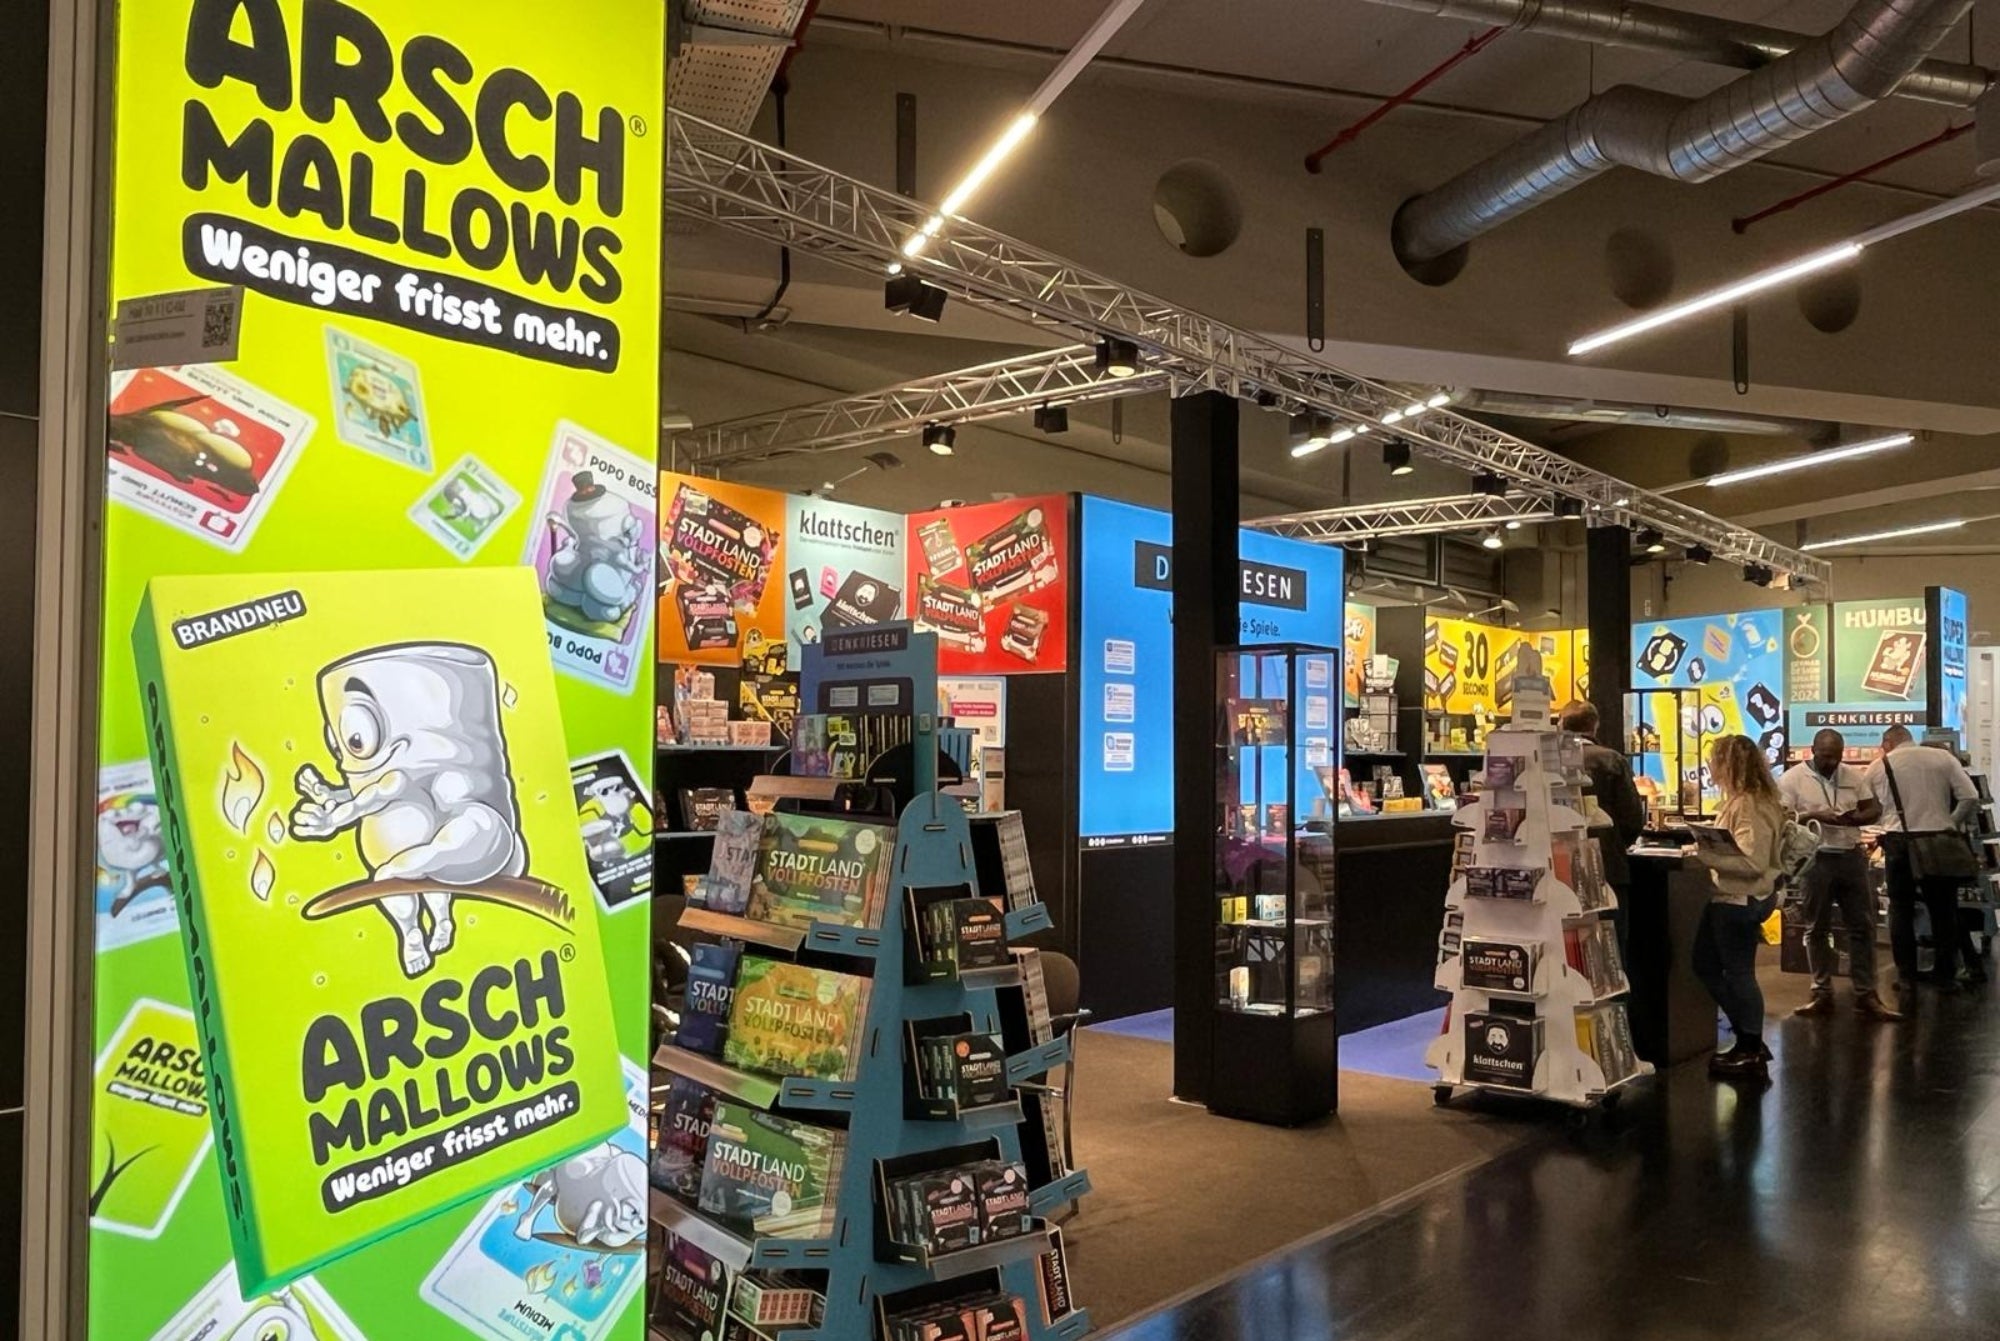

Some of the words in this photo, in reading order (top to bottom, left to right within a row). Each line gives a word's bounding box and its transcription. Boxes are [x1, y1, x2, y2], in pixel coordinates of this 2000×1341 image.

[185, 0, 624, 217] ARSCH
[182, 99, 622, 304] MALLOWS
[201, 224, 381, 305] Weniger
[395, 273, 502, 334] frisst
[513, 313, 609, 360] mehr.
[590, 456, 624, 480] POPO
[678, 518, 725, 549] STADT
[723, 539, 761, 569] LAND
[800, 509, 895, 548] klattschen
[676, 533, 757, 579] VOLLPFOSTEN
[972, 552, 1008, 577] STADT
[1008, 534, 1040, 557] LAND
[177, 594, 303, 646] BRANDNEU
[924, 597, 956, 613] STADT
[955, 606, 979, 620] LAND
[1250, 619, 1281, 639] Spiele.
[566, 640, 602, 664] POPO
[1464, 630, 1489, 680] 30
[1462, 682, 1489, 697] SECONDS
[1818, 714, 1914, 724] DENKRIESEN
[768, 867, 861, 894] VOLLPFOSTEN
[769, 850, 819, 872] STADT
[819, 858, 864, 879] LAND
[1469, 956, 1497, 966] STADT
[691, 981, 736, 1001] STADT
[302, 949, 567, 1104] ARSCH
[745, 997, 791, 1021] STADT
[796, 1005, 841, 1030] LAND
[1473, 1055, 1524, 1071] klattschen
[308, 1025, 575, 1166] MALLOWS
[331, 1149, 436, 1202] Weniger
[441, 1116, 509, 1158] frisst
[513, 1089, 576, 1129] mehr.
[713, 1141, 762, 1170] STADT
[762, 1155, 805, 1182] LAND
[711, 1158, 802, 1198] VOLLPFOSTEN
[1049, 1248, 1063, 1279] STADT
[665, 1265, 694, 1294] STADT
[693, 1286, 718, 1311] LAND
[514, 1300, 555, 1332] MEDIUM
